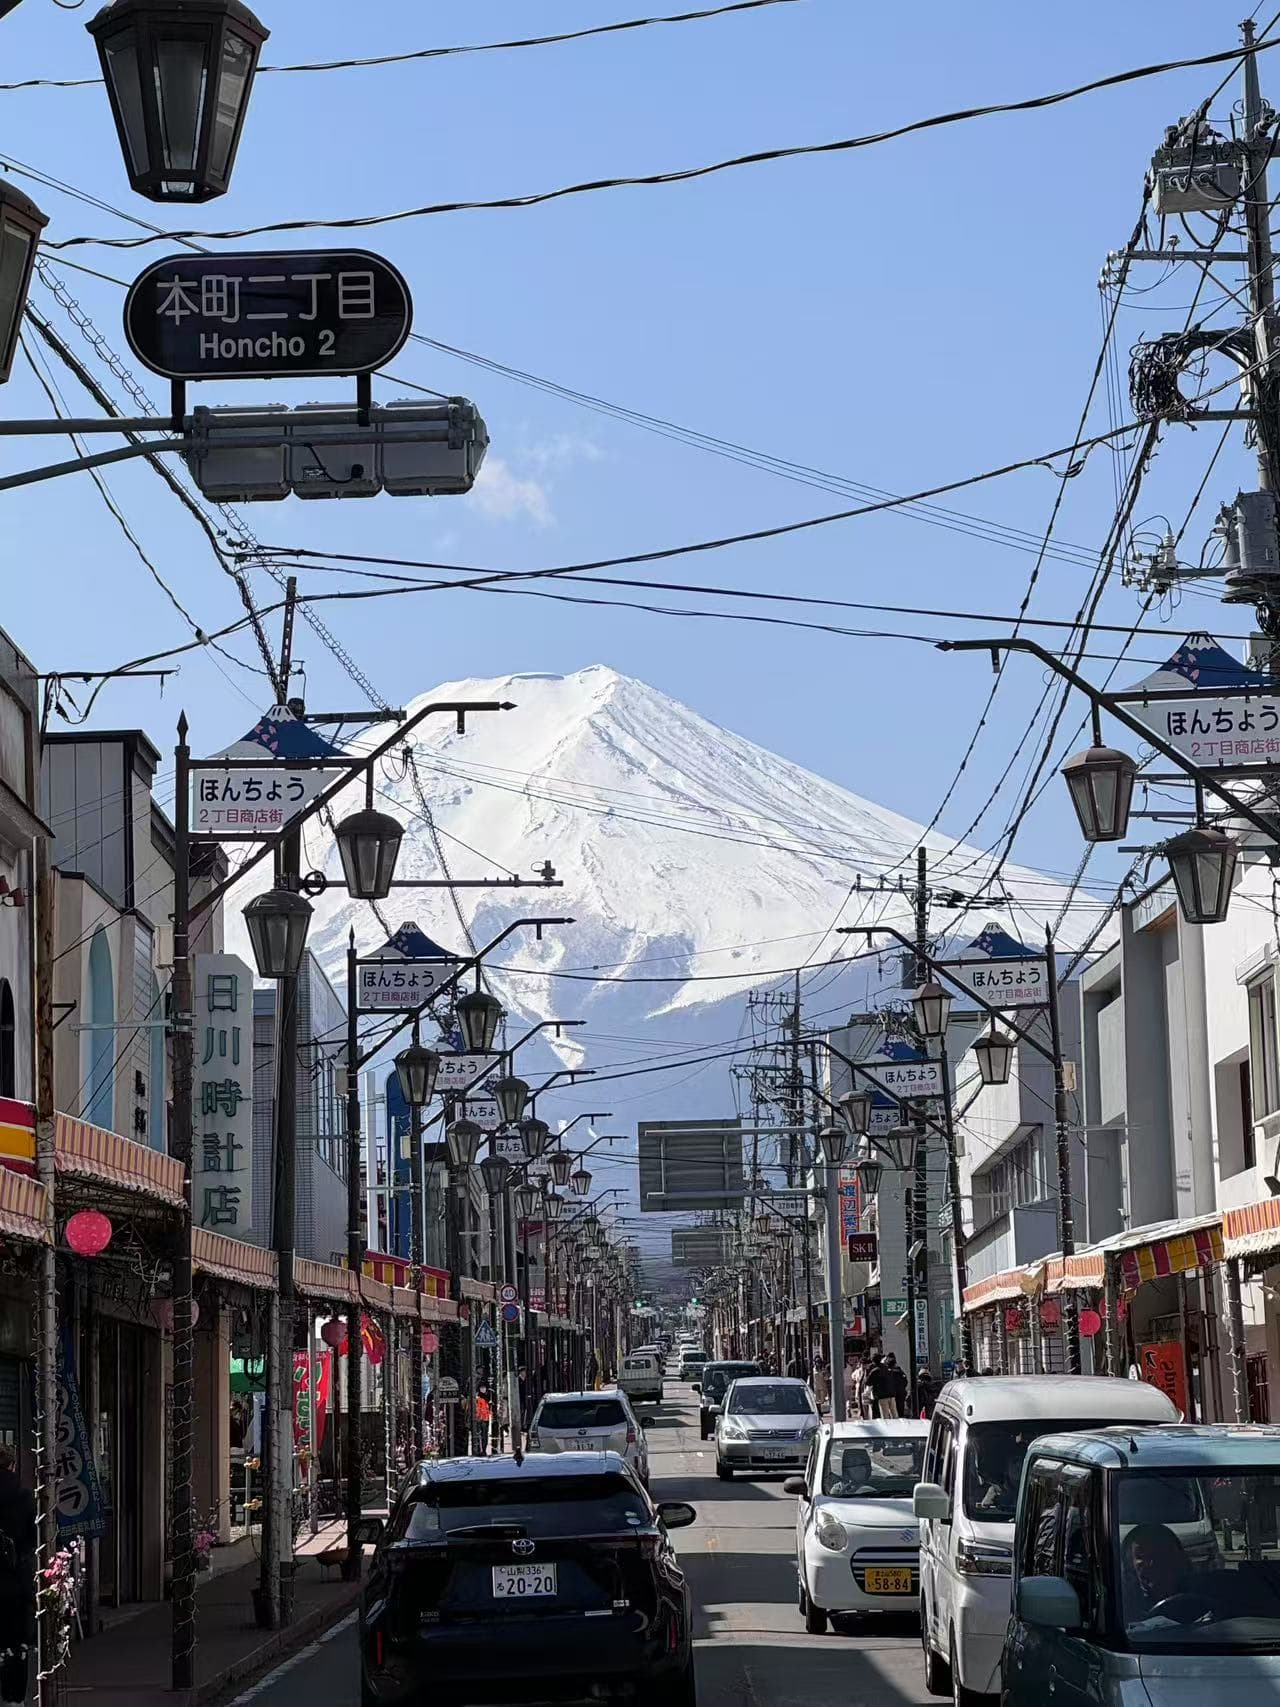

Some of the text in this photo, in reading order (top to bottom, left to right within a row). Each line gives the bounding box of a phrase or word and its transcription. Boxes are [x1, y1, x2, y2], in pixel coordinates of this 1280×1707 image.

[156, 271, 375, 326] 本町二丁目
[199, 329, 336, 359] Honcho 2
[1166, 705, 1279, 736] ほんちょう
[200, 776, 305, 802] ほんちょう
[199, 808, 284, 824] 2丁目商店街
[363, 970, 435, 988] ほんちょう
[972, 967, 1041, 987] ほんちょう
[885, 1066, 938, 1084] ほんちょう
[201, 973, 244, 1226] 日川時計店
[507, 1565, 542, 1577] 山梨 336
[506, 1576, 553, 1595] 20-20
[874, 1578, 909, 1591] 58-84
